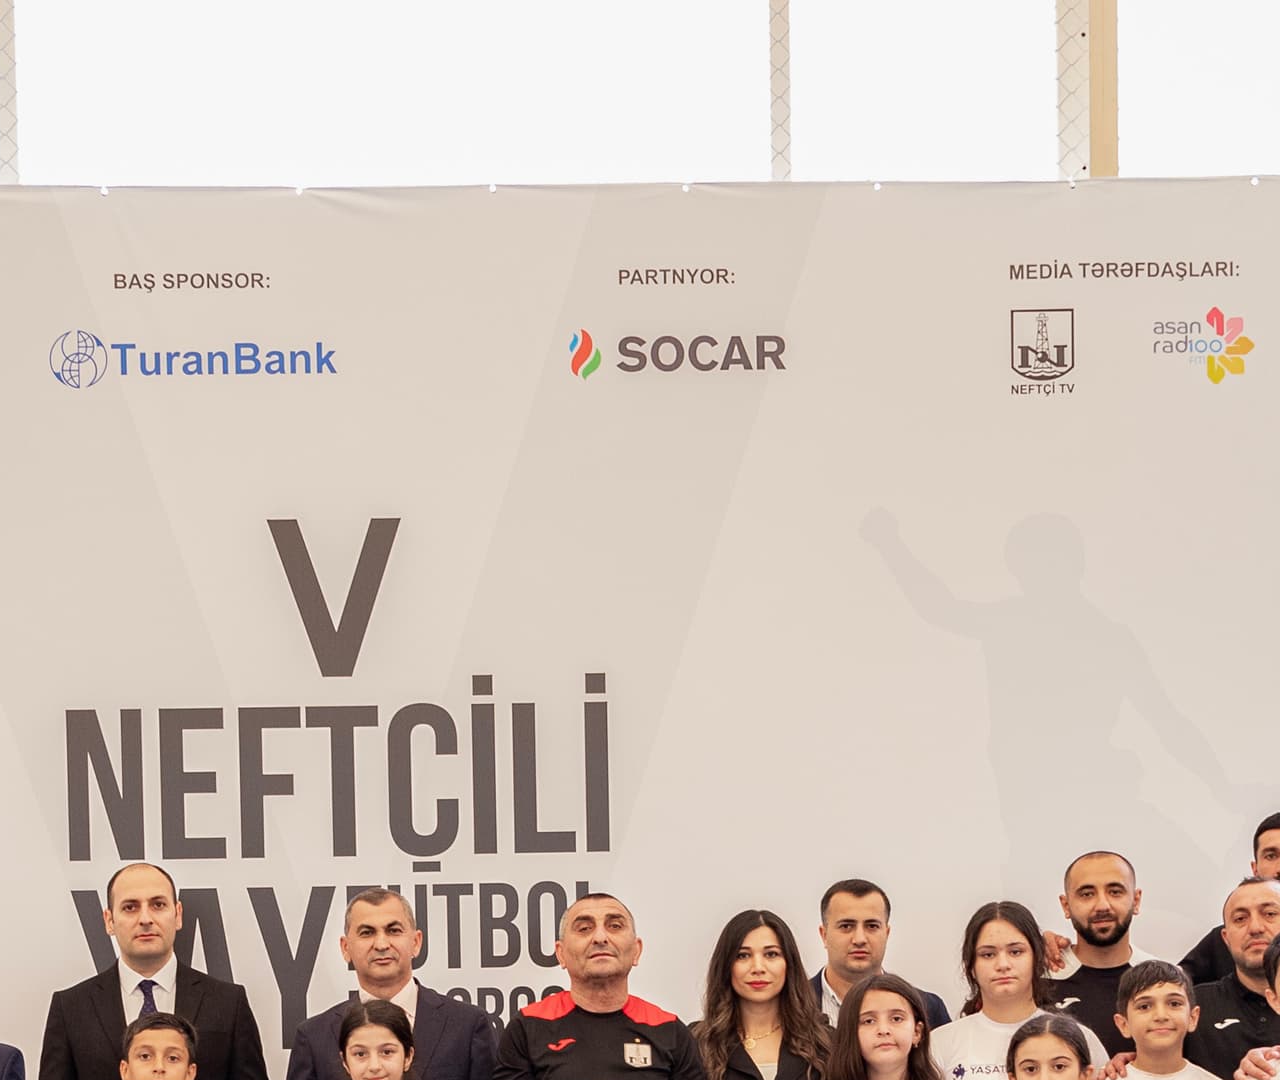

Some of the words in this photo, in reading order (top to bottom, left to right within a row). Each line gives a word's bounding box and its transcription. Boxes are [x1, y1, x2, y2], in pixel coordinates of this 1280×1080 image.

[618, 268, 736, 285] PARTNYOR:
[1009, 260, 1073, 280] MEDİA
[1078, 261, 1240, 281] TƏRƏFDAŞLARI:
[113, 273, 156, 293] BAŞ
[162, 272, 271, 289] SPONSOR:
[1153, 321, 1202, 335] asan
[110, 342, 338, 377] TuranBank
[616, 335, 787, 373] SOCAR
[1011, 381, 1056, 396] NEFTÇİ
[1058, 383, 1075, 394] TV
[266, 517, 401, 678] V
[64, 673, 611, 873] NEFTÇİLİ
